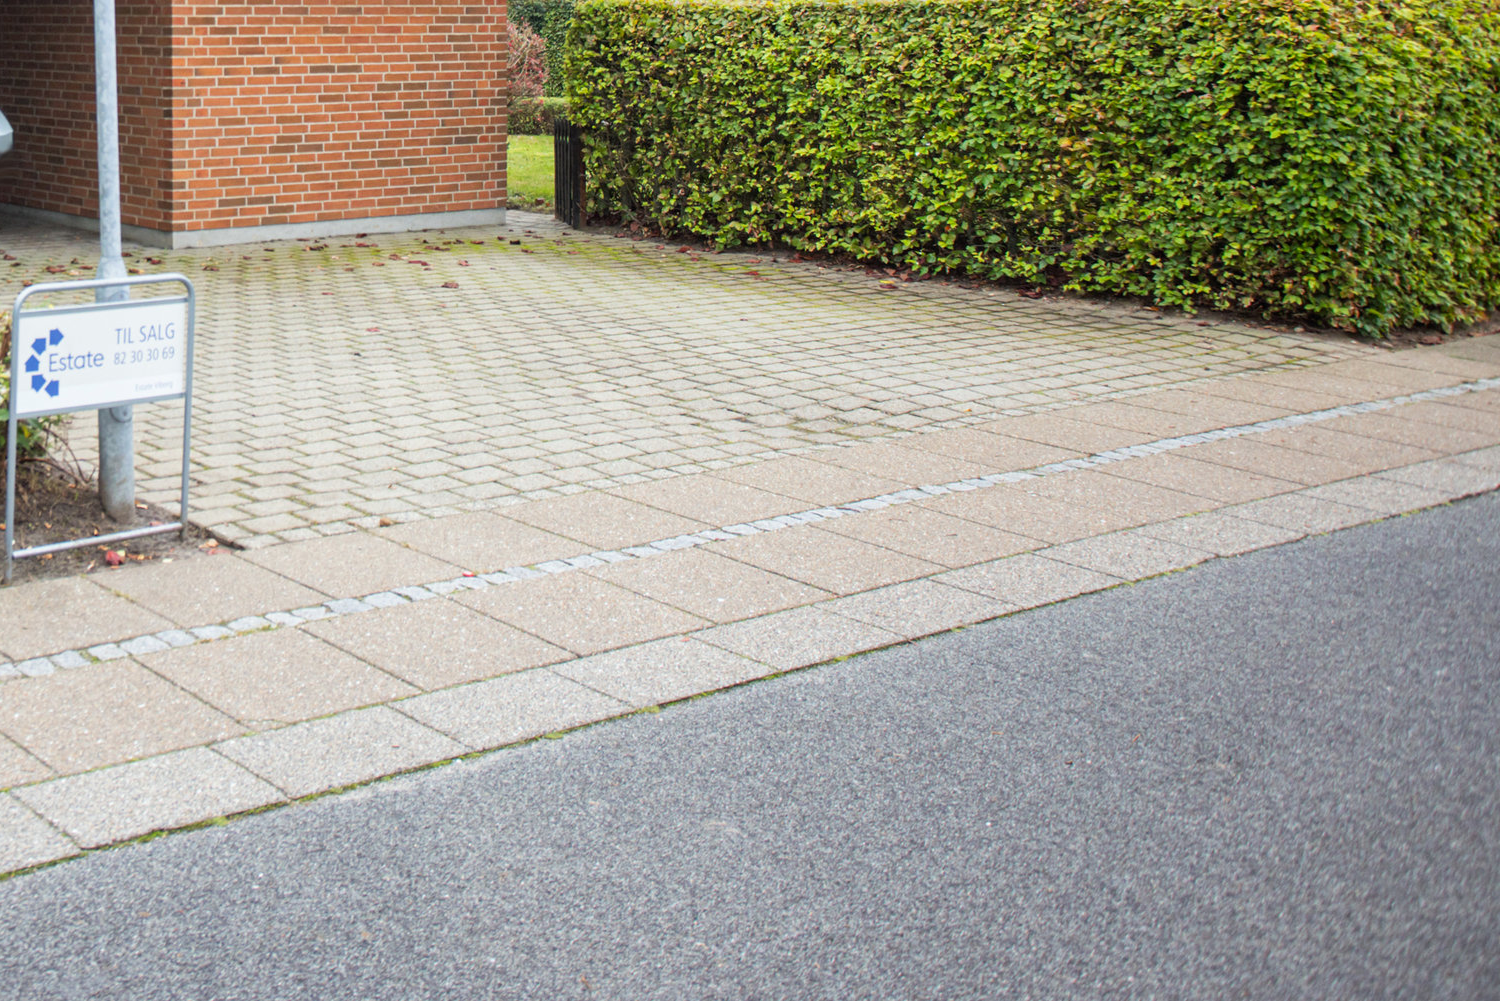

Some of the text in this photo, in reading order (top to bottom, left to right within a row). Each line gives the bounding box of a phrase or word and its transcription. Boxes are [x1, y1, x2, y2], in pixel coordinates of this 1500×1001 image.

[115, 322, 175, 345] TIL SALG
[49, 351, 105, 372] Estate
[113, 345, 176, 366] 82 30 30 69
